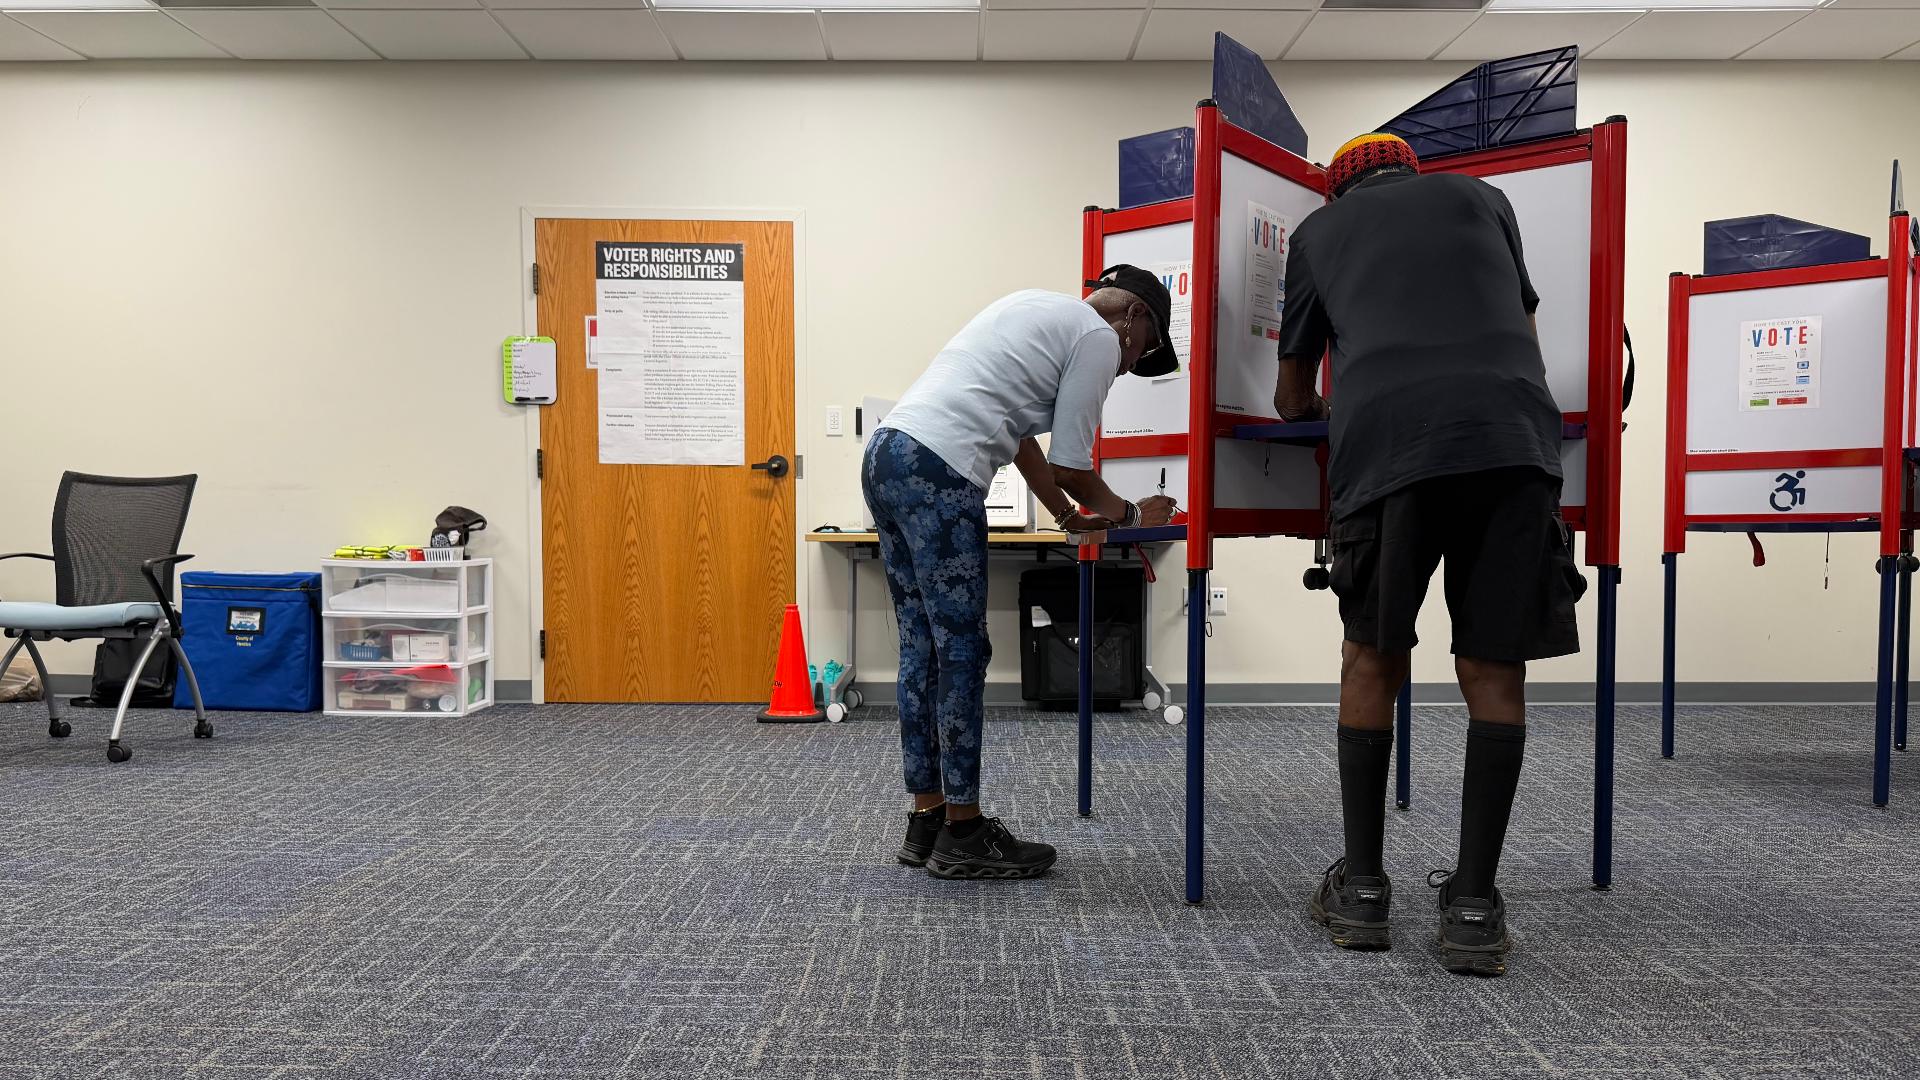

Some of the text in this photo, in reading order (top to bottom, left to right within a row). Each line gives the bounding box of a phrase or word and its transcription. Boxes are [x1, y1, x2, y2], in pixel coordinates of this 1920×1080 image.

[1254, 216, 1286, 255] VOTE
[603, 247, 736, 264] VOTER RIGHTS AND
[604, 263, 728, 280] RESPONSIBILITIES
[1162, 272, 1188, 296] VO
[1752, 325, 1808, 347] VOTE
